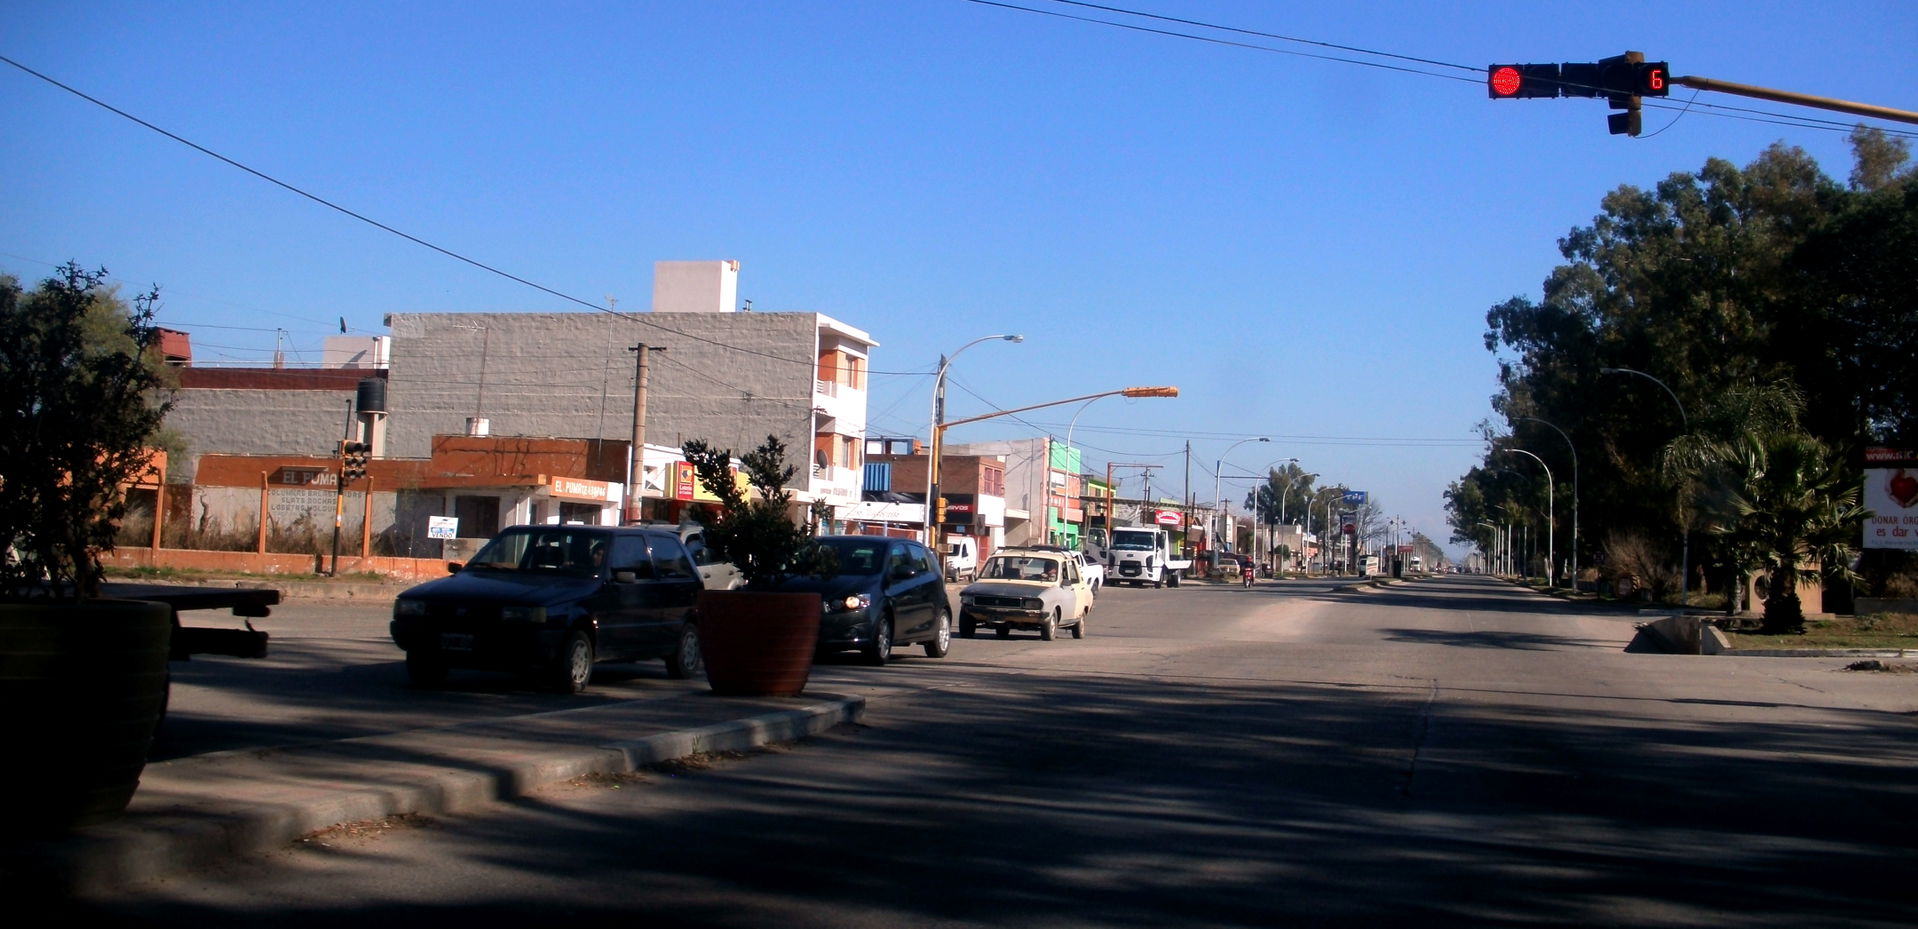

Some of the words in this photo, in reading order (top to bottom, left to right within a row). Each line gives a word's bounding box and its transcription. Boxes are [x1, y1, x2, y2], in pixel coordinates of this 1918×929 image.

[1652, 69, 1663, 89] 6
[283, 472, 298, 484] EL
[303, 472, 337, 485] PUMA
[555, 480, 562, 493] EL
[1871, 515, 1898, 525] DONAR
[1876, 528, 1886, 537] es
[1892, 525, 1909, 537] dar
